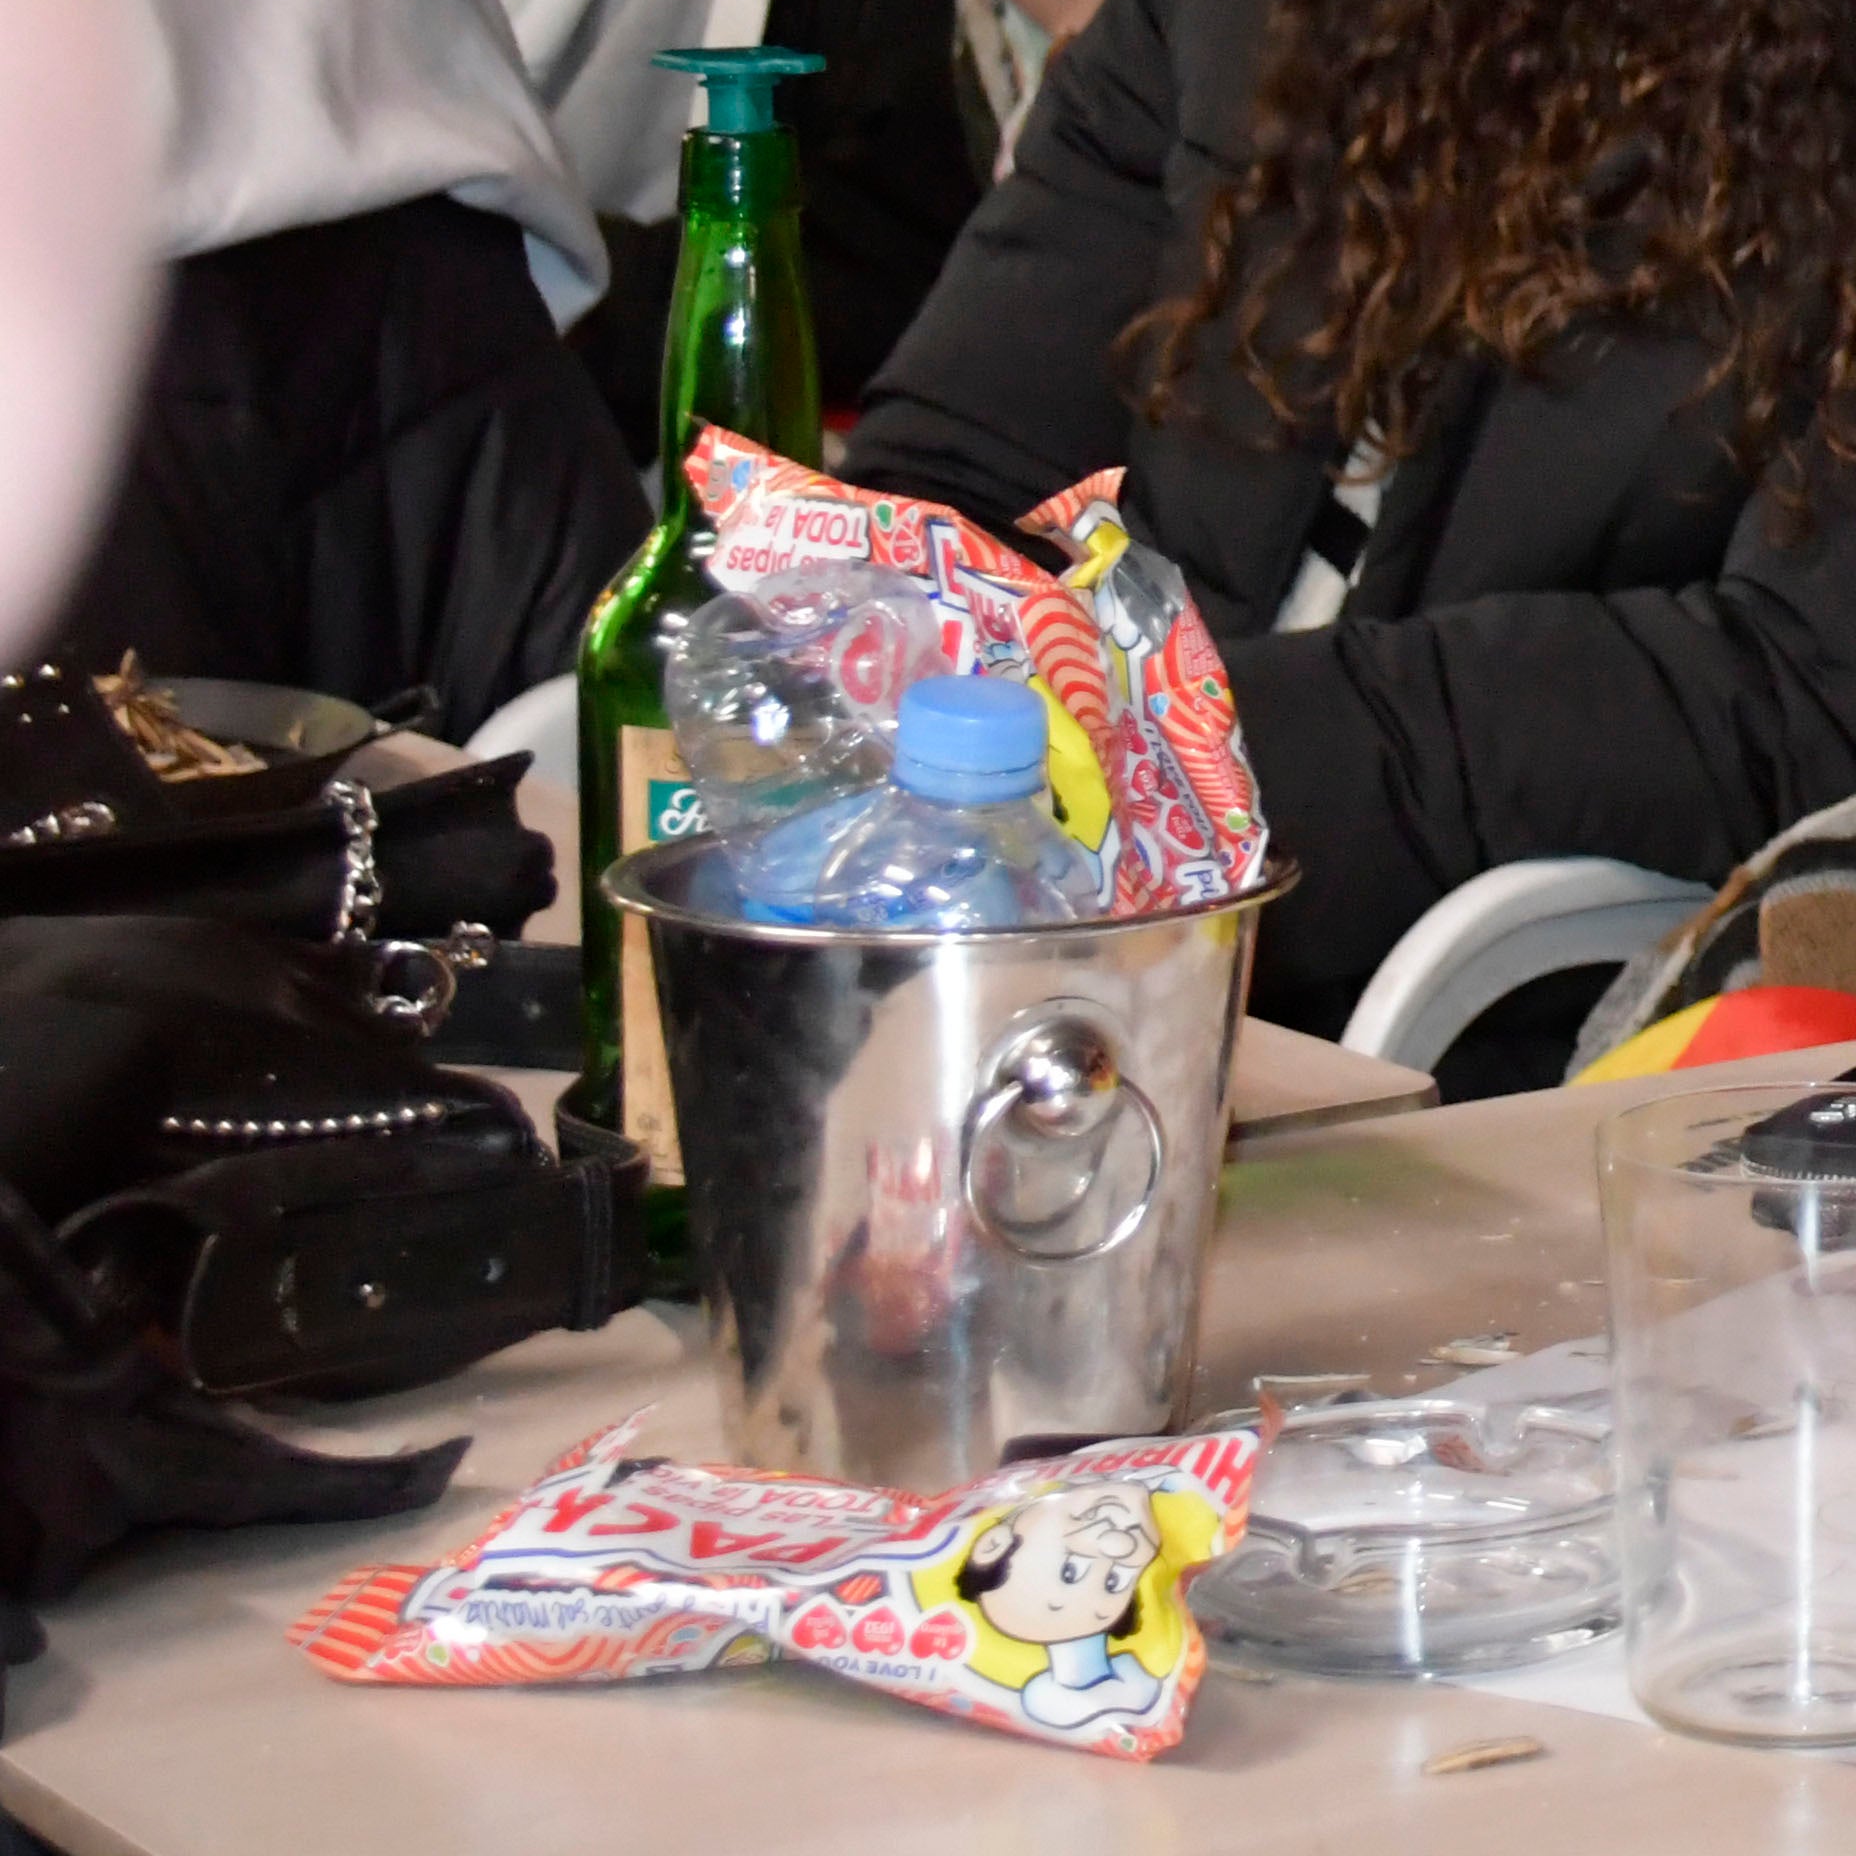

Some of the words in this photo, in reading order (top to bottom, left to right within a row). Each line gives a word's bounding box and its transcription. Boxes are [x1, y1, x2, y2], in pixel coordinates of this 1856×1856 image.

[793, 507, 862, 548] TODA
[758, 1489, 881, 1514] TODA
[867, 1661, 921, 1681] LOVE
